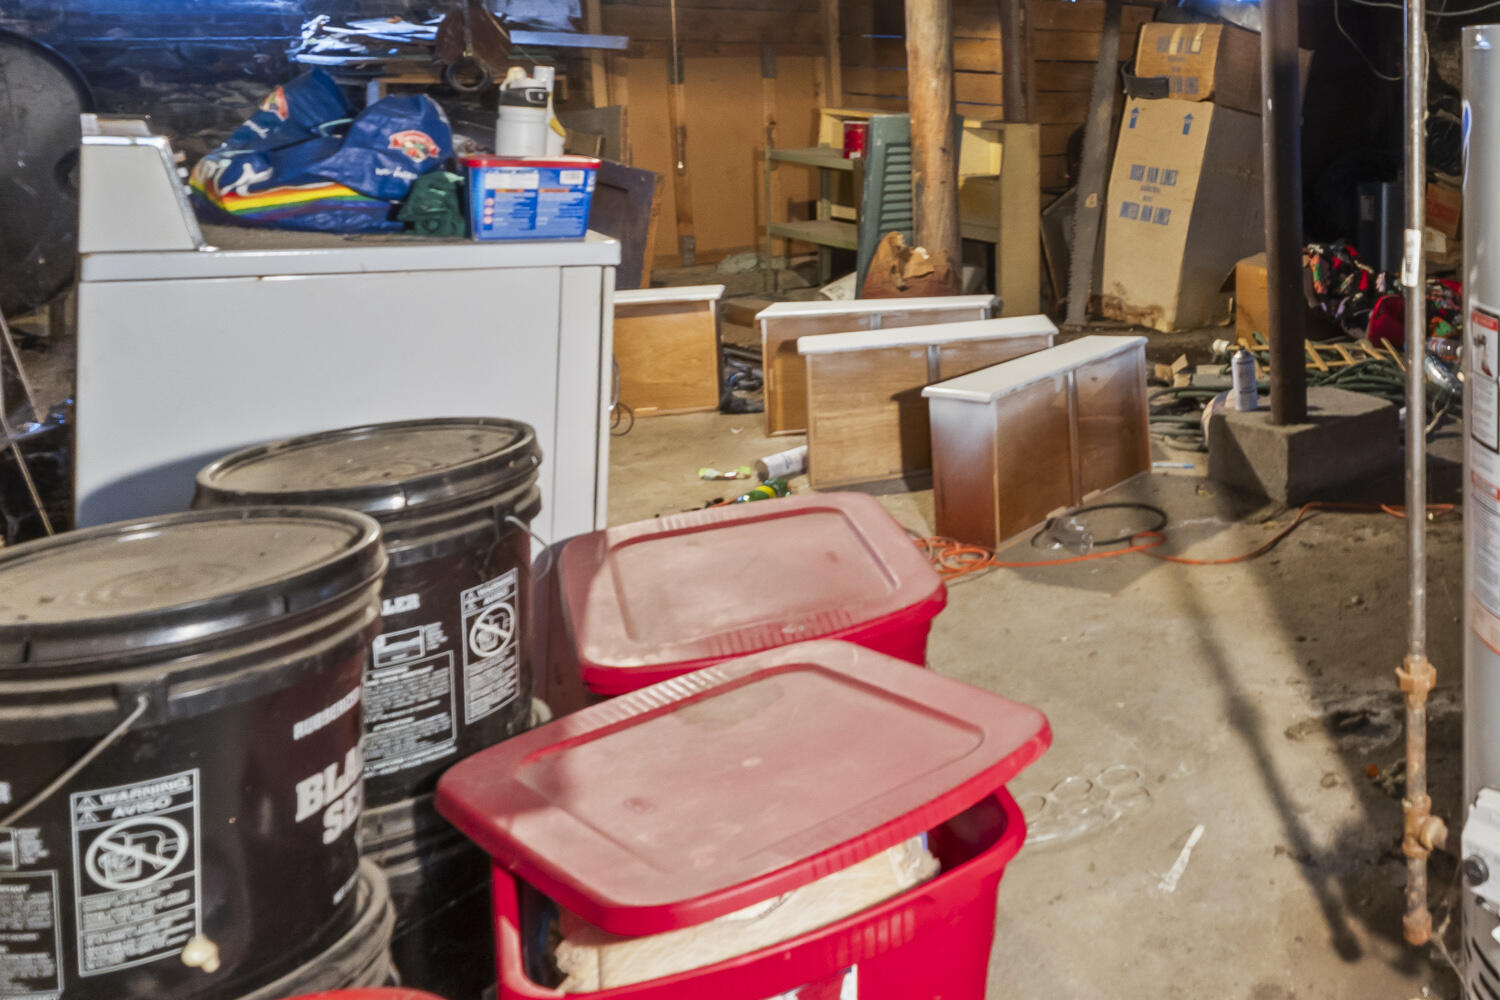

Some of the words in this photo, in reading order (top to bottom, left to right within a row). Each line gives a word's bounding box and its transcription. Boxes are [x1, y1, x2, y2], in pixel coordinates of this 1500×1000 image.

[100, 776, 194, 806] WARNING
[112, 795, 172, 819] AVISO
[295, 746, 362, 823] BLA
[323, 784, 362, 845] SE
